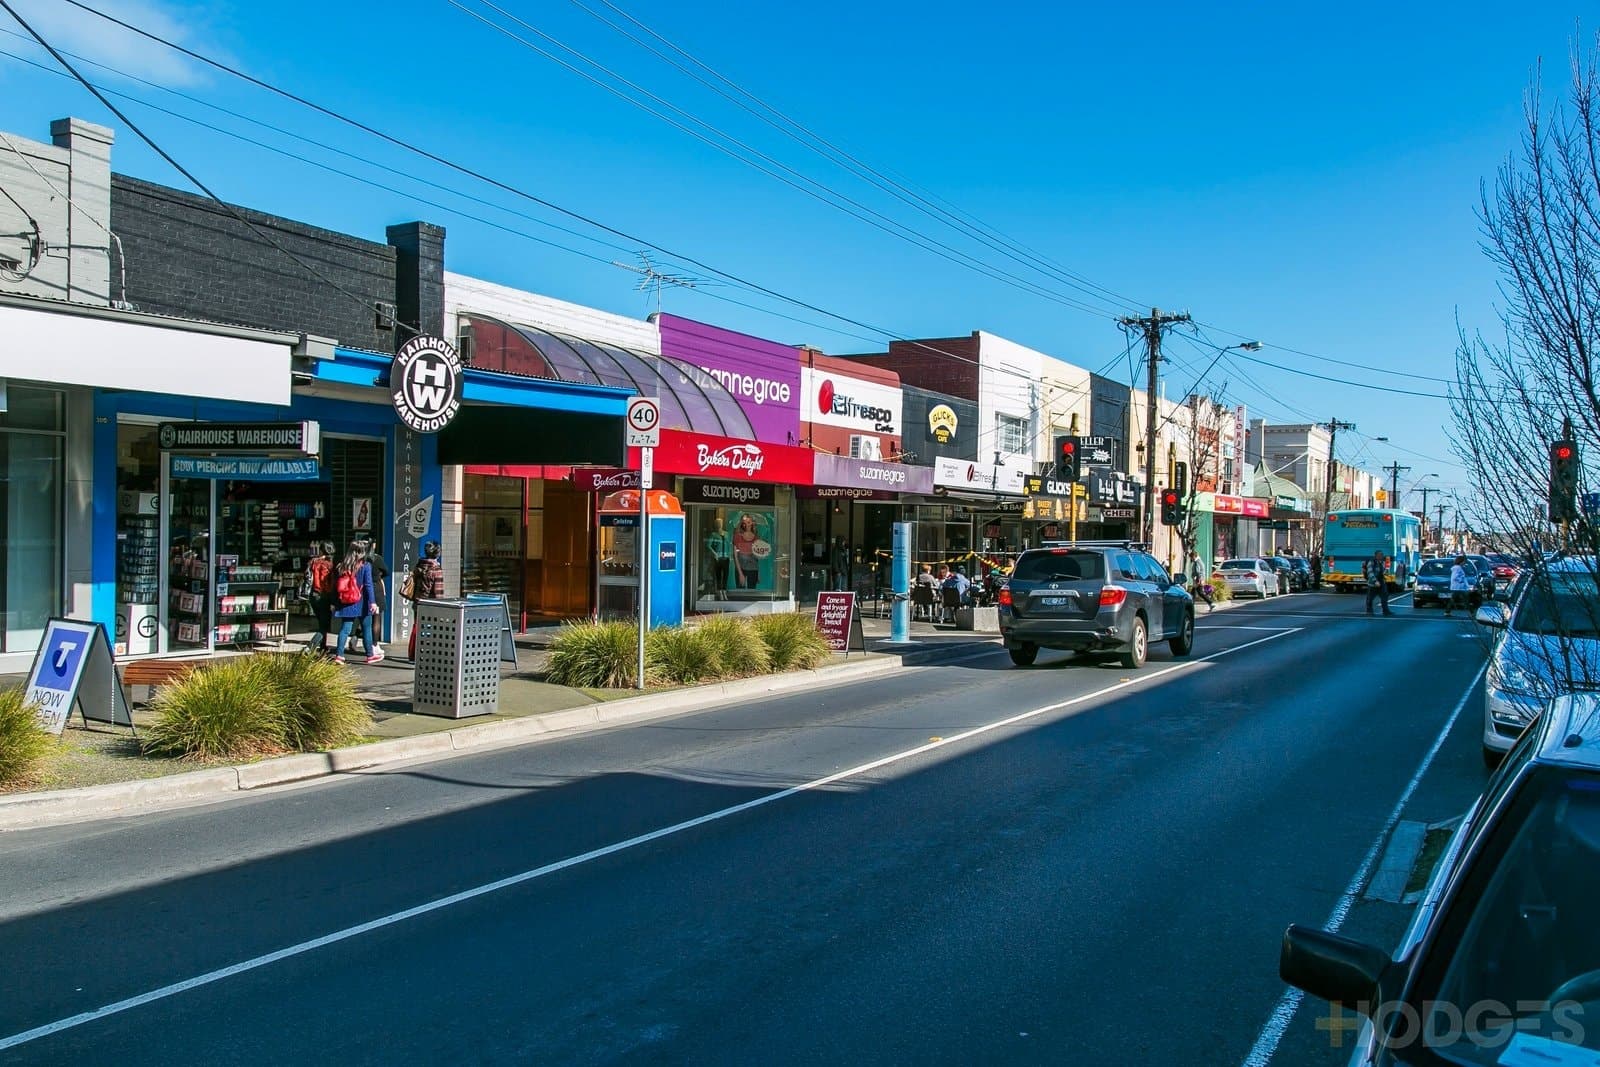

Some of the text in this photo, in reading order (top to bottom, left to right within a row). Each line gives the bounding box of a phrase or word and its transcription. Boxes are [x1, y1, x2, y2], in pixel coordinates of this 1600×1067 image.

[397, 337, 462, 375] HAIRHOUSE
[679, 364, 790, 404] suzannegrae
[393, 390, 459, 431] WAREHOUSE
[633, 408, 654, 423] 40
[177, 429, 302, 445] HAIRHOUSE WAREHOUSE
[1080, 437, 1104, 446] ELLER
[196, 461, 236, 474] PIERCING
[239, 461, 259, 473] NOW
[697, 444, 764, 477] Bakers Delight
[593, 474, 620, 489] Bakers
[859, 467, 905, 485] suzannegrae
[702, 485, 760, 502] suzannegrae
[818, 489, 873, 498] suzannegrae
[402, 542, 410, 639] WAREOUSE
[31, 690, 65, 708] NOW
[36, 708, 61, 726] PEN
